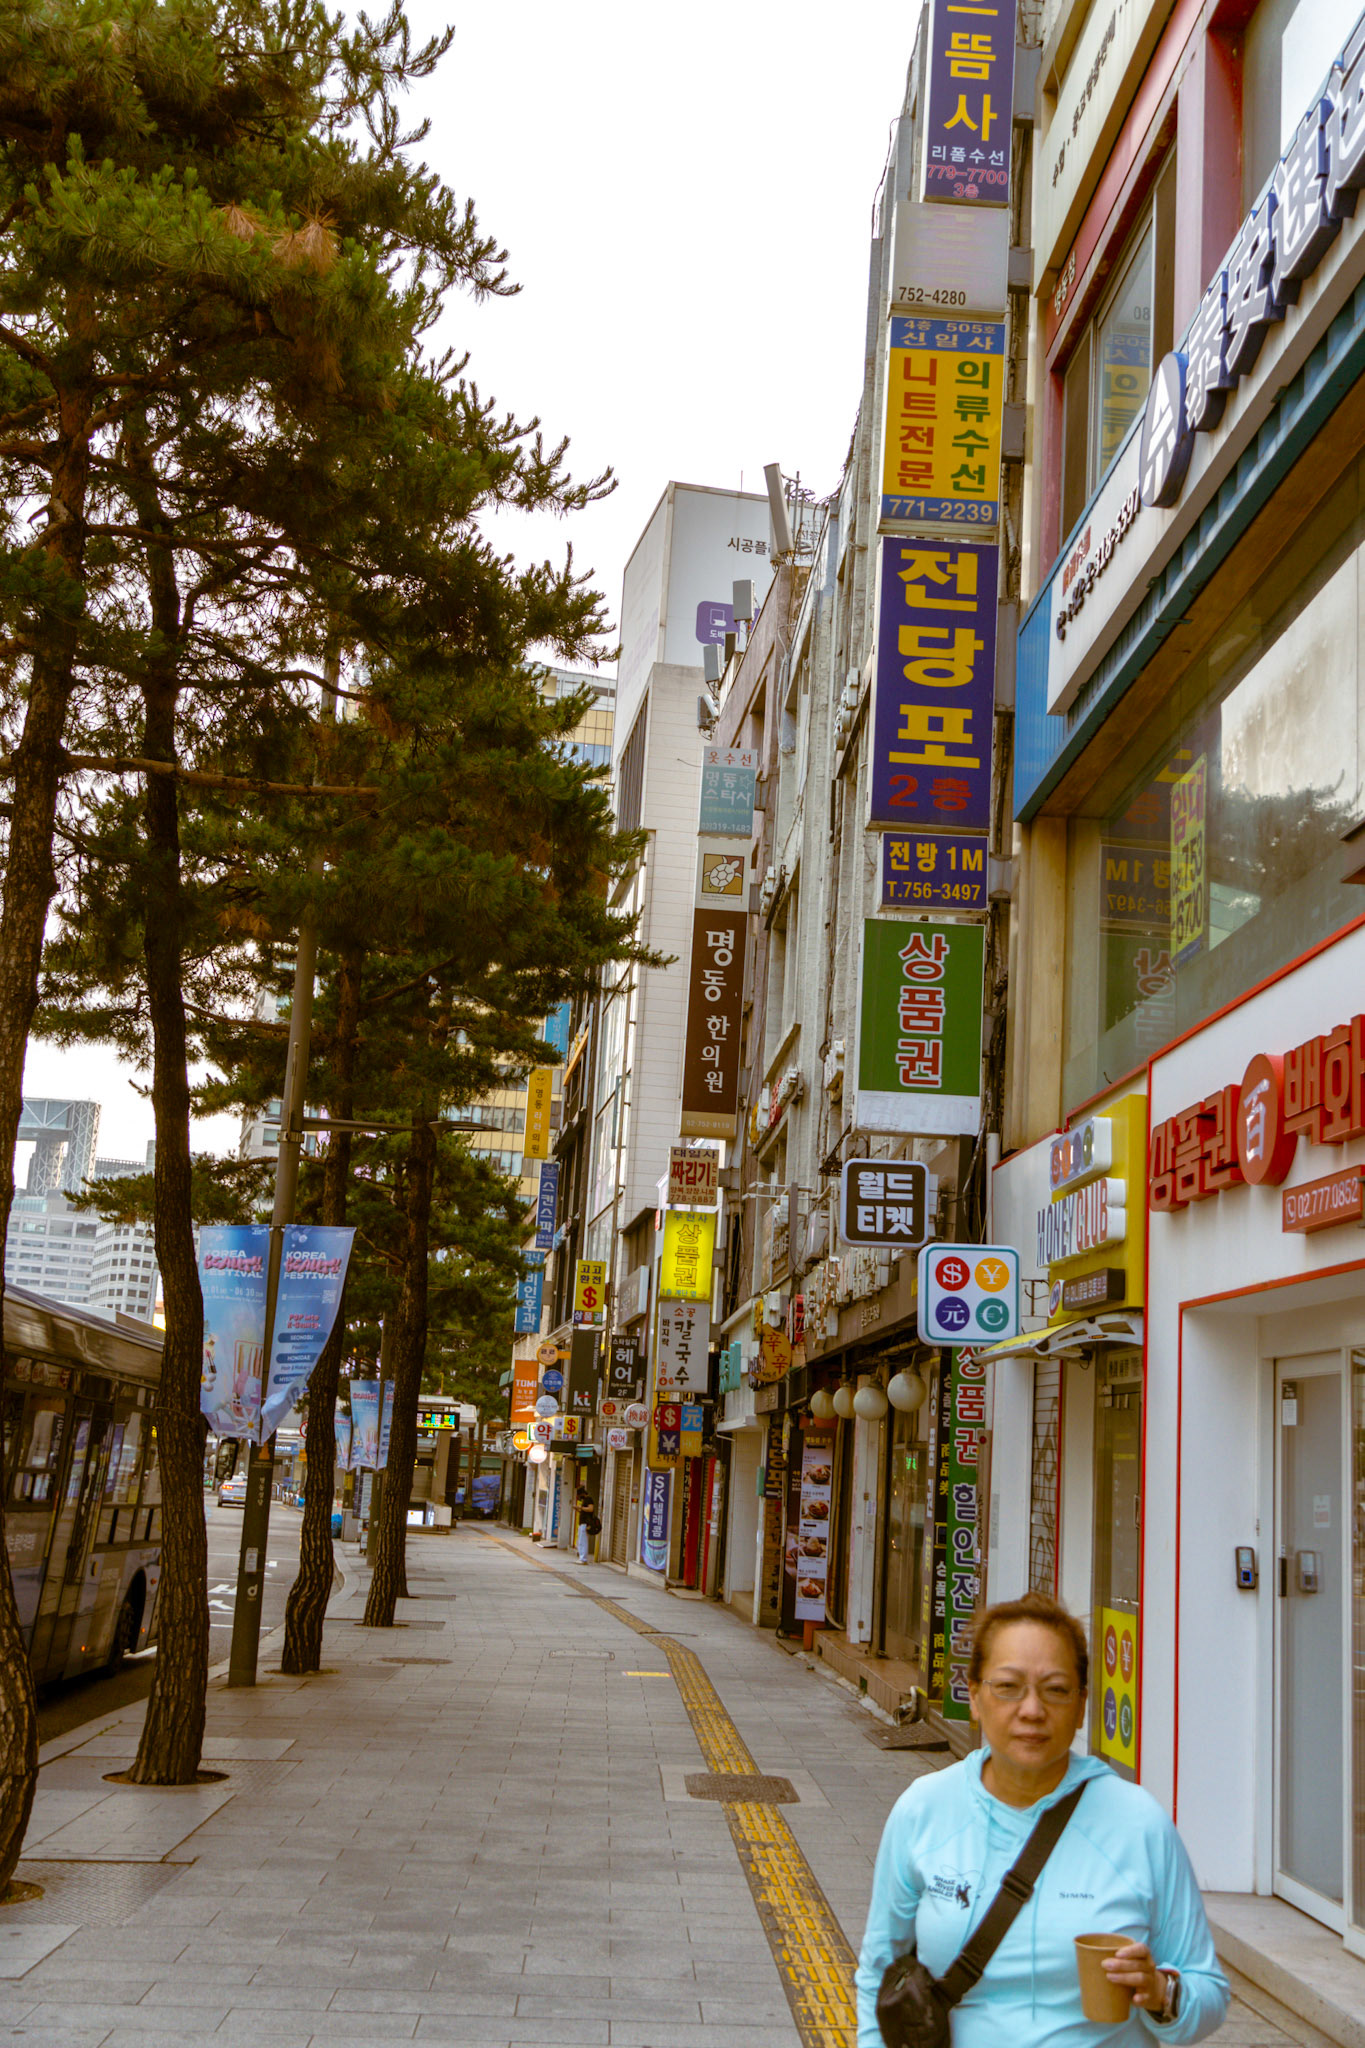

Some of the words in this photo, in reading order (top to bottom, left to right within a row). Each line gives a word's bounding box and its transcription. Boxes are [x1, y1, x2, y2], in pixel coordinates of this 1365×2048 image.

[931, 145, 1004, 166] 리폼수선
[926, 164, 1008, 185] 779-7700
[953, 183, 979, 199] 3층
[899, 287, 966, 306] 752-4280
[903, 319, 932, 332] 4층
[946, 321, 996, 335] 505호
[900, 331, 995, 351] 신일사
[897, 357, 938, 489] 니트전문
[950, 360, 991, 493] 의류수선
[888, 498, 993, 522] 771-2239
[727, 537, 771, 556] 시공플
[889, 548, 984, 770] 전당포
[707, 751, 752, 767] 옷수선
[705, 771, 737, 788] 명동
[888, 774, 972, 812] 2층
[889, 841, 938, 873] 전방
[945, 845, 984, 872] 1M
[886, 880, 981, 902] T.756-3497
[700, 929, 735, 1002] 명동
[896, 932, 950, 1089] 상품권
[700, 1014, 731, 1094] 한의원
[857, 1170, 914, 1201] 월드
[1297, 1176, 1359, 1220] 02.777.0852
[856, 1204, 914, 1236] 티켓
[1036, 1192, 1076, 1268] MONEY
[1075, 1177, 1108, 1254] CLUB
[285, 1251, 327, 1260] KOREA
[674, 1224, 702, 1288] 상품권
[283, 1271, 340, 1280] FESTIVAL
[942, 1262, 963, 1285] $
[980, 1264, 1002, 1285] ¥
[582, 1286, 597, 1308] $
[674, 1307, 696, 1318] 소공
[942, 1304, 965, 1324] 元
[674, 1320, 695, 1386] 칼국수
[614, 1348, 634, 1384] 헤어
[515, 1379, 537, 1388] TOMI
[617, 1389, 628, 1397] 2F
[573, 1390, 592, 1407] kt
[954, 1346, 986, 1466] 상품권
[566, 1418, 576, 1433] $
[664, 1407, 676, 1428] $
[683, 1409, 701, 1427] 元
[537, 1424, 552, 1441] 약
[662, 1434, 677, 1452] ¥
[1106, 1634, 1116, 1666] $
[1121, 1639, 1132, 1672] ¥
[1105, 1700, 1115, 1729] 元
